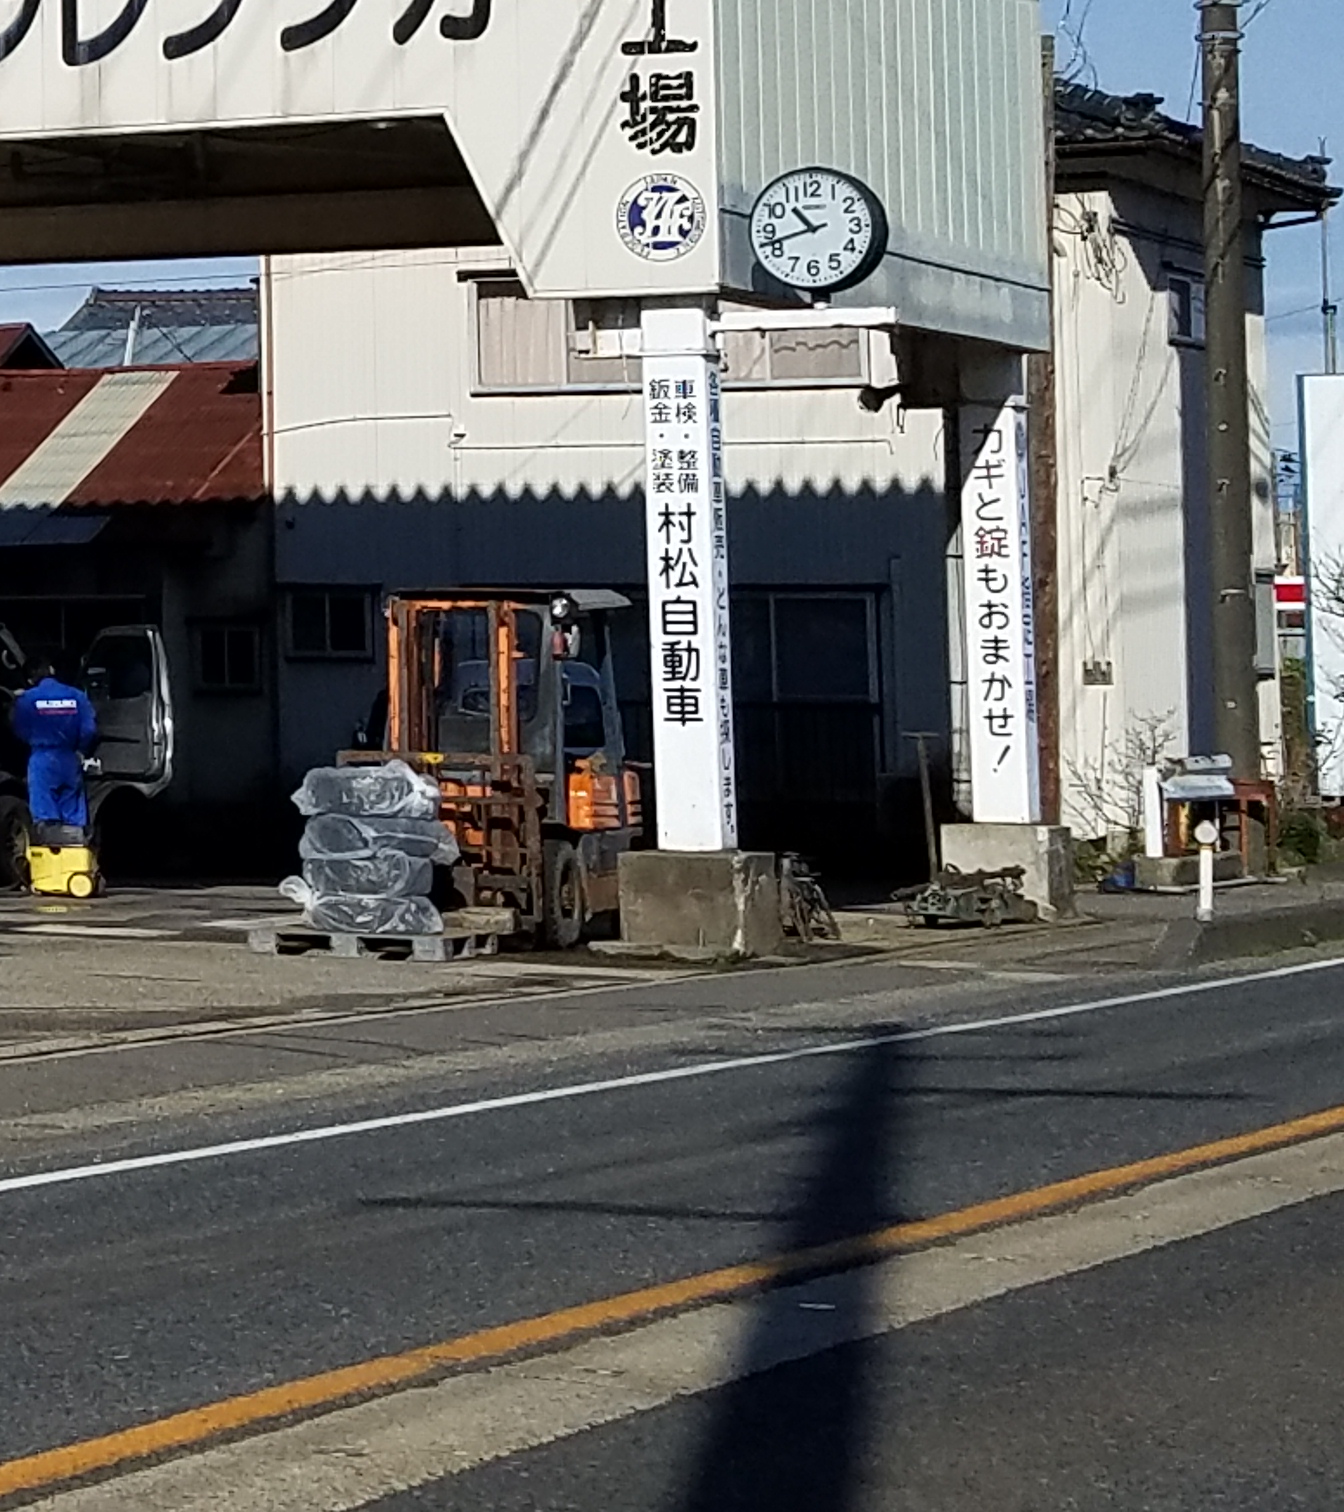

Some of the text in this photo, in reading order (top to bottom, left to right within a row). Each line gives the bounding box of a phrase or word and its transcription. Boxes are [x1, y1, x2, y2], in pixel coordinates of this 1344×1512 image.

[784, 185, 799, 203] 11
[803, 180, 822, 198] 12
[842, 196, 857, 214] 2
[762, 223, 776, 240] 9
[848, 216, 862, 234] 3
[842, 237, 856, 254] 4
[787, 256, 801, 273] 7
[806, 259, 820, 277] 6
[828, 253, 841, 270] 5
[657, 502, 704, 728] 村松自動車
